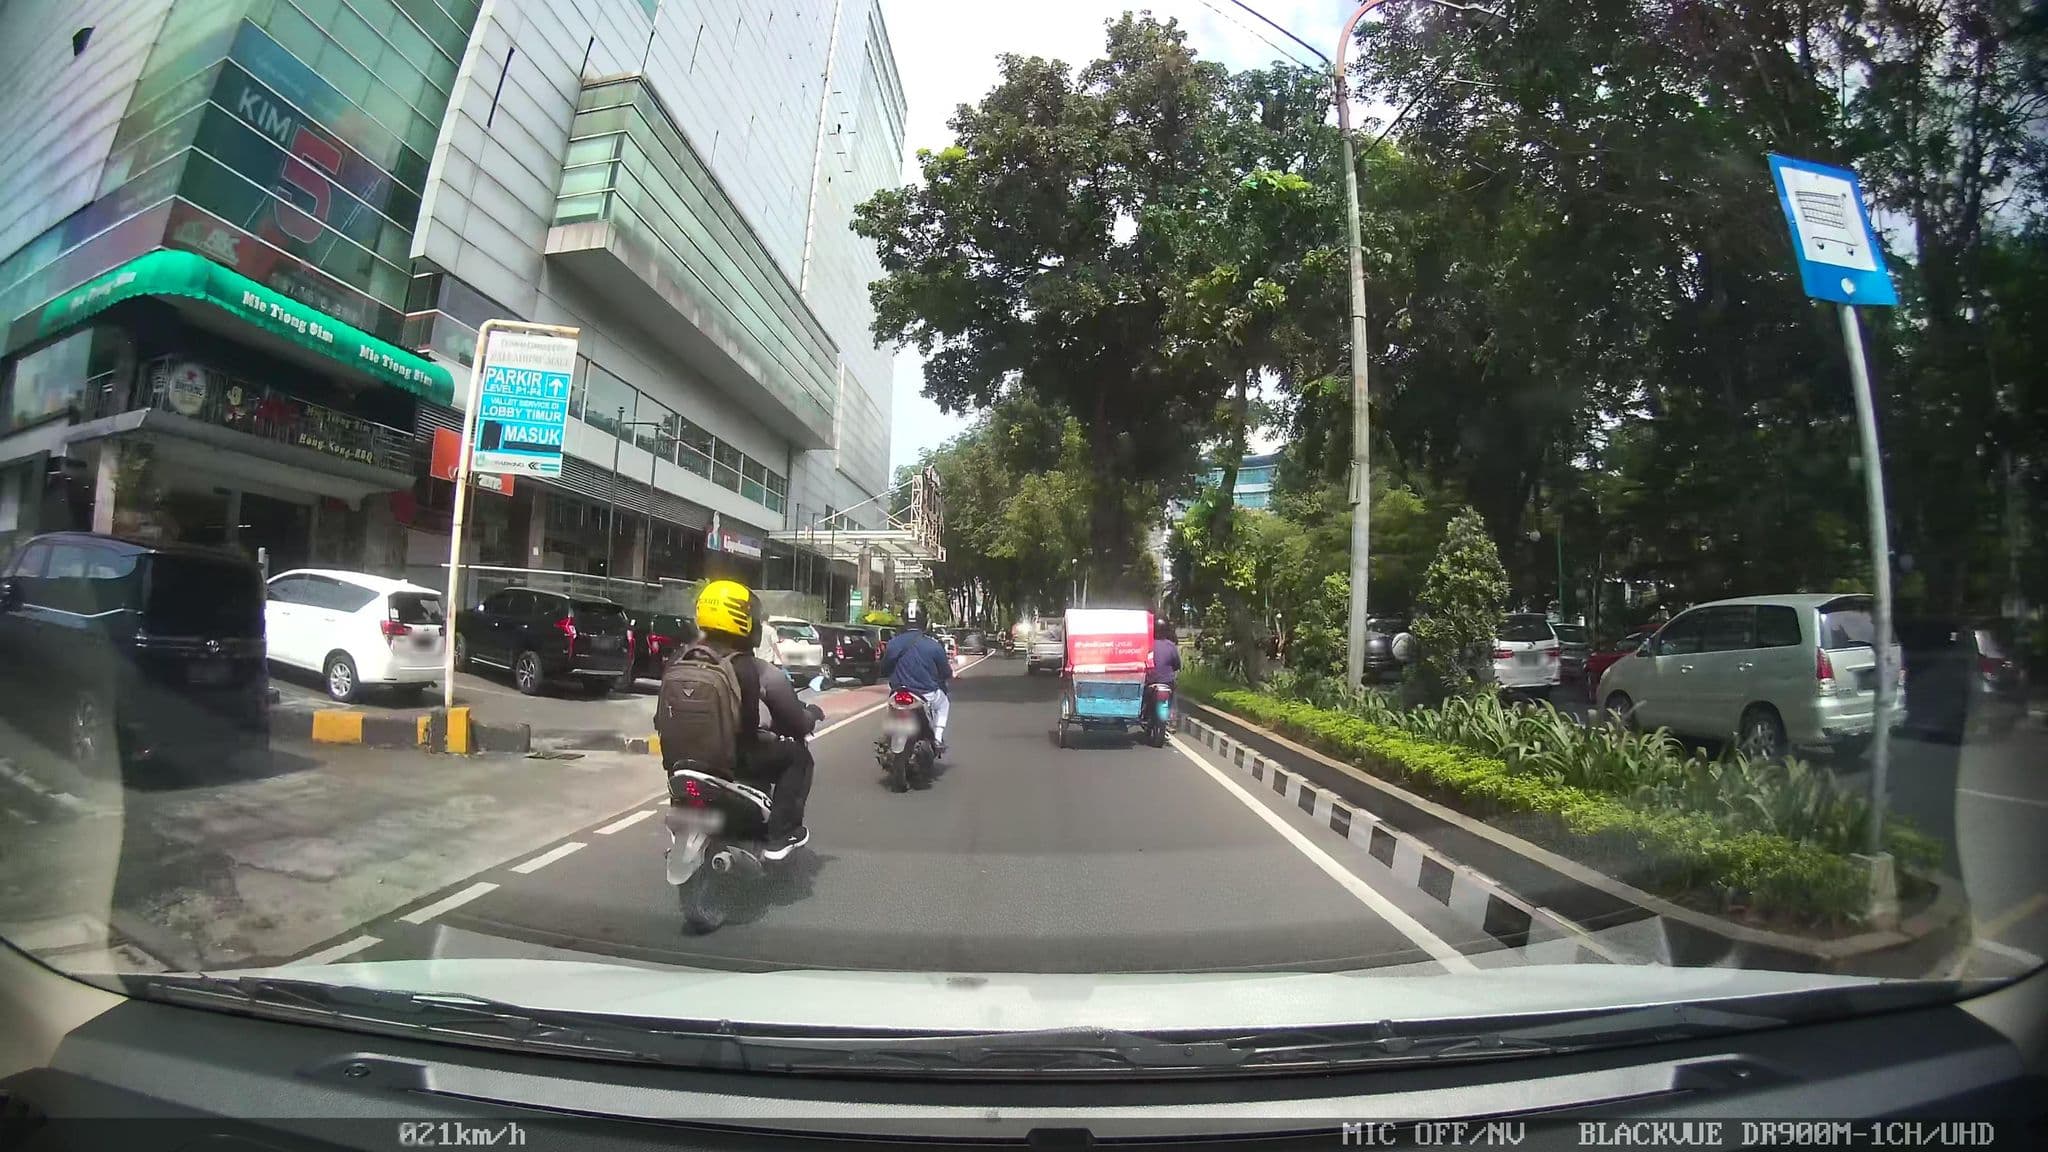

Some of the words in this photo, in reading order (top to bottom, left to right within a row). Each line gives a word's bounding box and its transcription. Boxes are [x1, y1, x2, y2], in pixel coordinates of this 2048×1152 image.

[239, 87, 292, 142] KIM
[274, 124, 345, 244] 5
[270, 302, 307, 334] Tiong
[309, 321, 334, 344] Sim
[486, 367, 543, 387] PARKIR
[484, 383, 513, 394] LEVEL
[482, 405, 524, 420] LOBBY
[526, 408, 562, 423] TIMUR
[504, 424, 560, 445] MASUK
